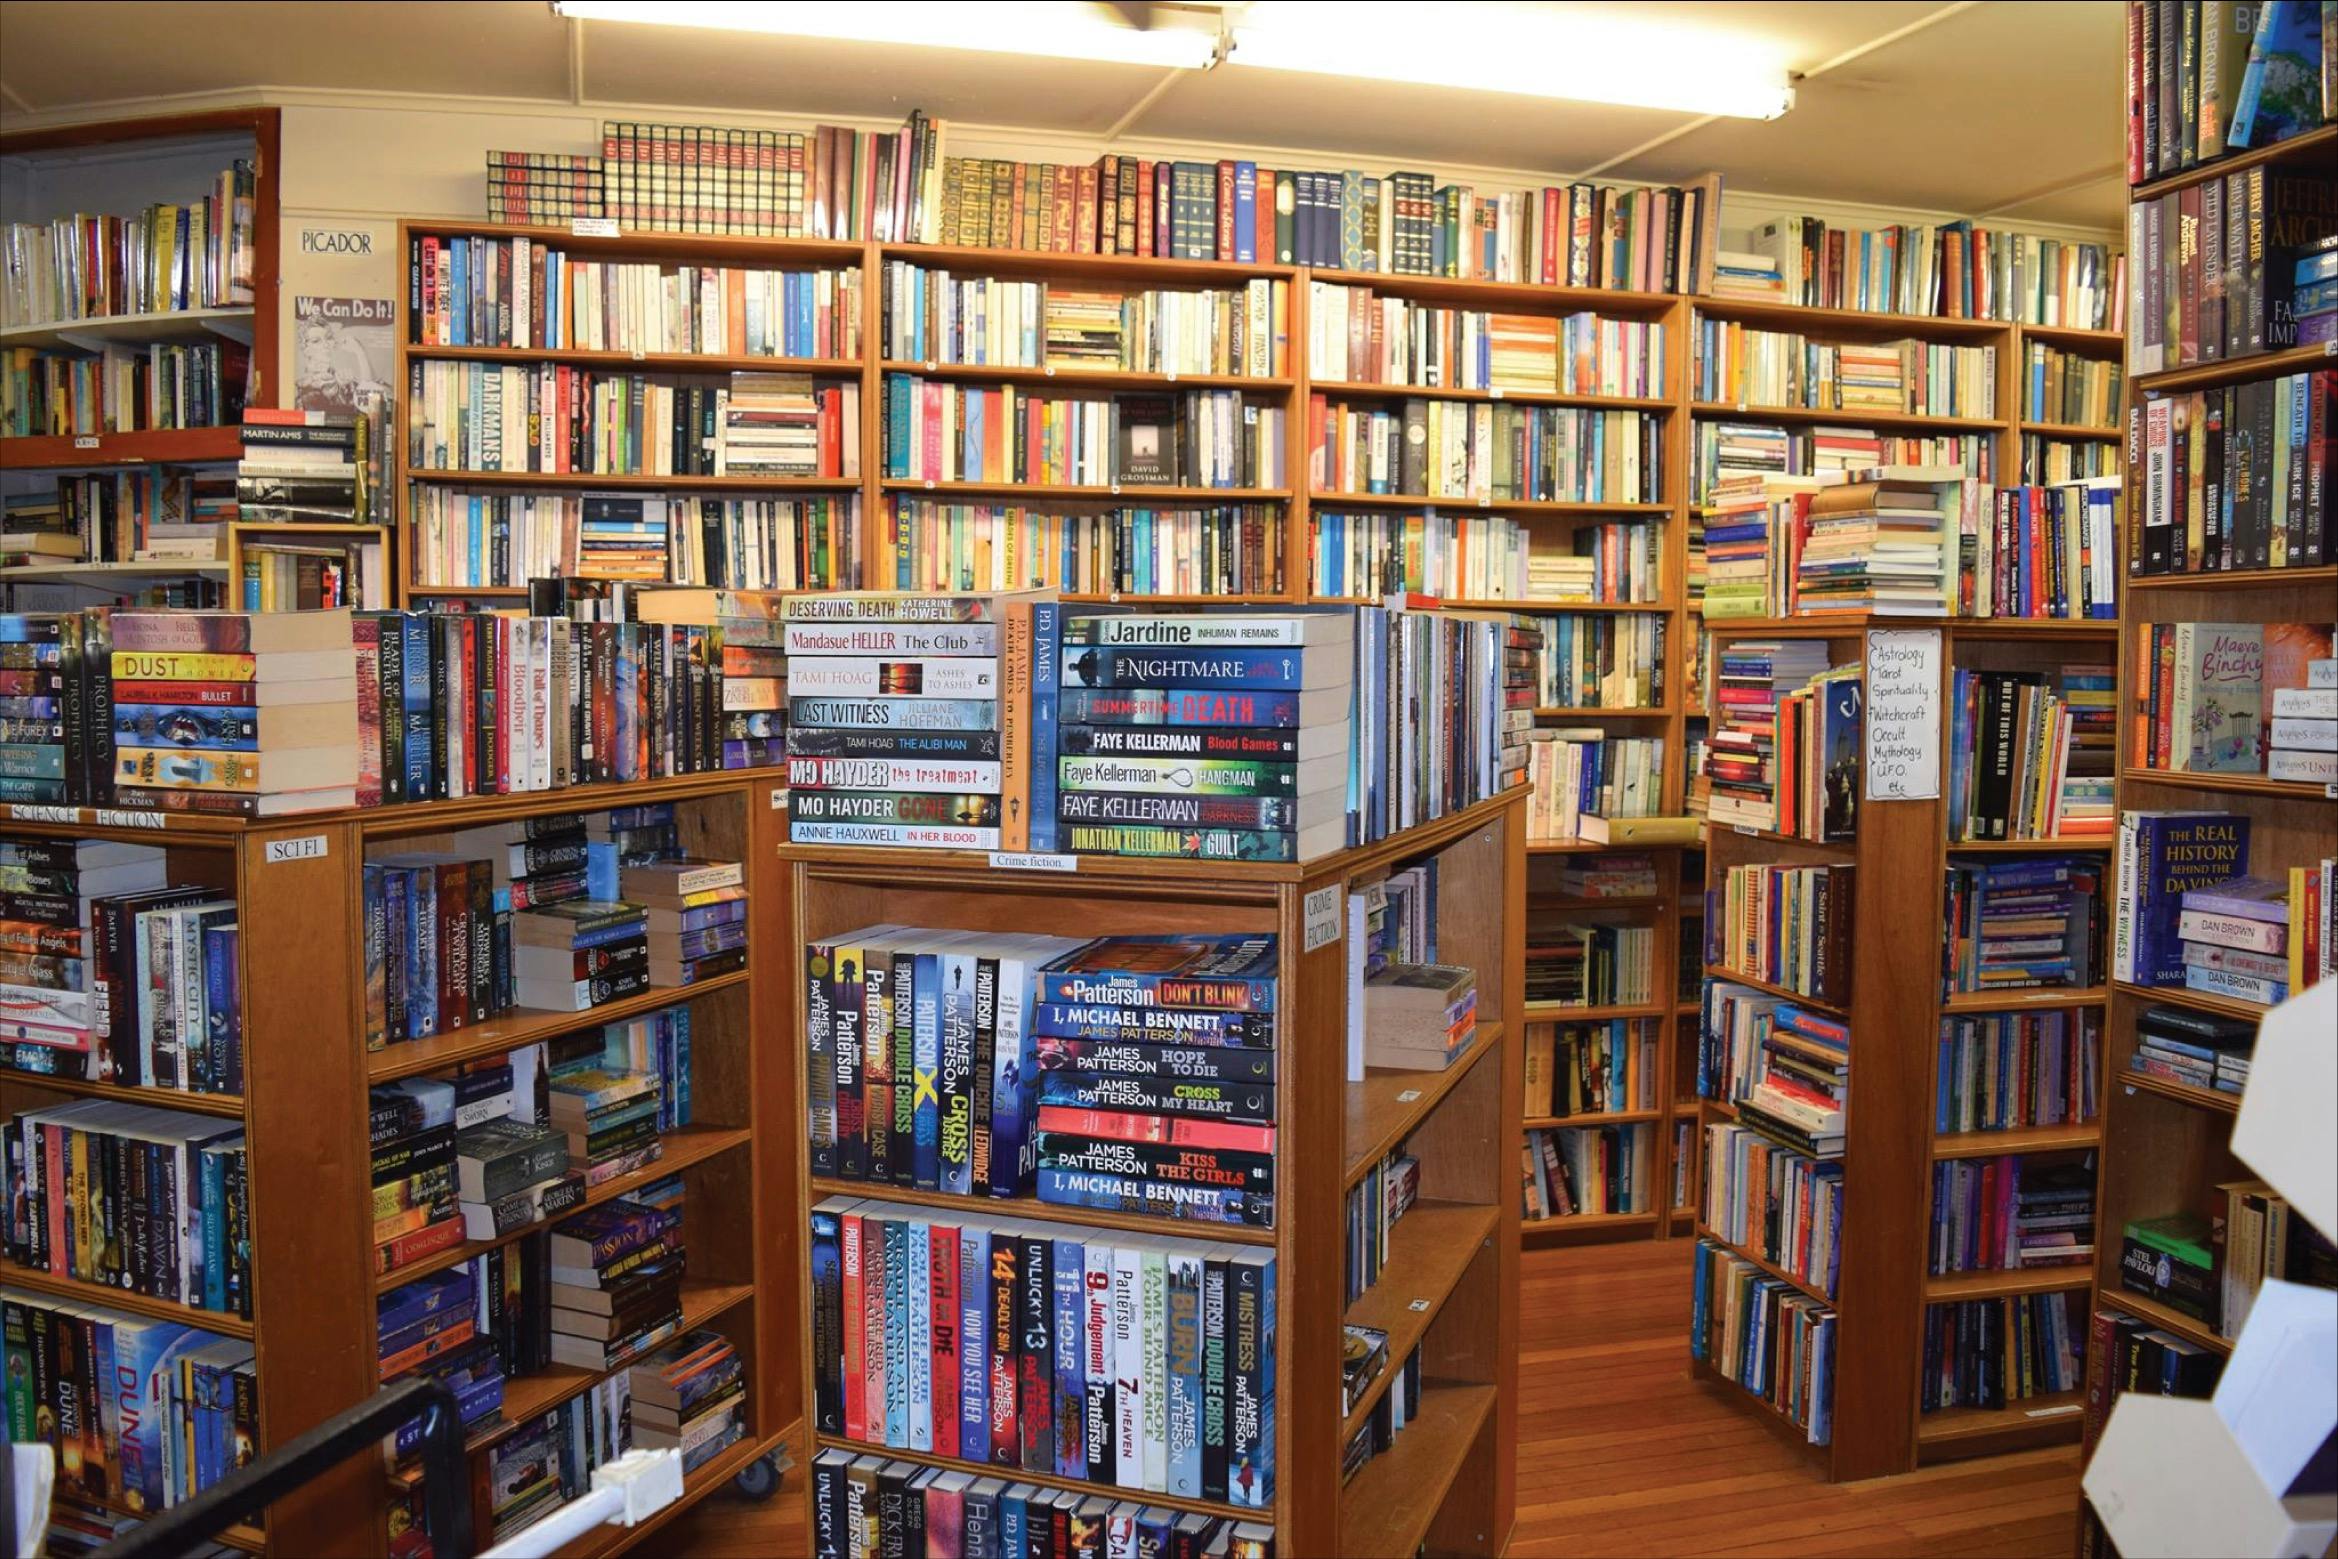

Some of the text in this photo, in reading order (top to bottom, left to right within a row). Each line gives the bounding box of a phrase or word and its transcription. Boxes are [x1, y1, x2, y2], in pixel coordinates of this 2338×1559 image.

[2204, 30, 2218, 95] BROWN
[2250, 172, 2262, 262] JEFFREY ARCHER
[302, 231, 372, 254] PICADOR
[2181, 215, 2190, 266] Andrews
[297, 296, 393, 319] We Can Do It!
[521, 285, 529, 325] ATWOOD
[483, 372, 501, 463] DARKMANS
[2157, 406, 2168, 448] WEAPONS
[243, 429, 279, 439] MARTIN
[280, 430, 302, 440] AMIS
[2149, 419, 2158, 448] CHOICE
[1120, 474, 1170, 482] GROSSMAN
[1130, 465, 1160, 473] DAVID
[2310, 460, 2320, 507] PROPHET
[789, 601, 896, 618] DESERVING DEATH
[900, 600, 954, 608] KATHERINE
[900, 607, 954, 621] HOWELL
[792, 632, 969, 650] Mandasue HELLER The Club
[1111, 621, 1280, 643] Jardine INHUMAN REMAINS
[2213, 634, 2261, 653] Maeve
[124, 657, 180, 677] DUST
[383, 631, 392, 698] FORTRIU
[391, 632, 400, 697] BLADE OF
[409, 628, 421, 686] MIRROR
[1878, 644, 1925, 669] Astrology
[2201, 651, 2264, 683] Binchy
[792, 671, 873, 685] TAMI HOAG
[1116, 658, 1125, 679] THE
[1126, 657, 1244, 681] NIGHTMARE
[1876, 667, 1902, 679] Tarot
[201, 691, 232, 702] BULLET
[513, 663, 528, 736] Bloodheir
[1872, 684, 1929, 701] Spirituality
[69, 679, 81, 761] PROPHECY
[95, 675, 109, 761] PROPHECY
[437, 659, 446, 769] ORCS INFERNO
[796, 703, 890, 725] LAST WITNESS
[907, 703, 955, 714] JILLIANE
[1091, 700, 1178, 715] SUMMERTIME
[1182, 695, 1254, 723] DEATH
[1873, 705, 1926, 722] Witchcraft
[900, 714, 962, 728] HOFFMAN
[1997, 681, 2013, 776] OUT OF THIS WORLD
[845, 737, 967, 750] TAMI HOAG THE ALIBI MAN
[1093, 733, 1279, 752] FAYE KELLERMAN Blood Games
[1872, 727, 1906, 743] Occult
[409, 714, 421, 781] MARILLIER
[1873, 747, 1922, 763] Mythology
[789, 760, 977, 787] MO HAYDER the treatment
[1064, 762, 1256, 787] Faye Kellerman HANGMAN
[1888, 782, 1906, 793] etc
[12, 806, 162, 828] SCIENCE FICTION
[798, 796, 949, 822] MO HAYDER GONE
[1063, 795, 1099, 817] FAYE
[1102, 797, 1199, 821] KELLERMAN
[798, 826, 977, 843] ANNIE HAUXWELL IN HER BLOOD
[1071, 828, 1239, 856] JONATHAN KELLERMAN GUILT
[2168, 825, 2237, 842] THE REAL
[273, 839, 318, 860] SCI FI
[996, 854, 1065, 868] Crime fiction.
[2166, 844, 2240, 862] HISTORY
[2171, 863, 2231, 875] BEHIND THE
[2165, 878, 2187, 894] DA
[1307, 890, 1332, 916] CRIME
[1307, 919, 1337, 948] FICTION
[2117, 896, 2130, 961] THE WITNESS
[2201, 919, 2220, 934] DAN
[2221, 921, 2256, 938] BROWN
[458, 911, 468, 998] CROSSROADS
[186, 920, 199, 1025] MYSTIC CITY
[1107, 975, 1138, 989] James
[2208, 971, 2261, 991] DAN BROWN
[1073, 980, 1246, 1006] Patterson DON'T BLINK
[1053, 1007, 1220, 1031] I, MICHAEL BENNETT
[1077, 1047, 1206, 1074] JAMES PATTERSON HOPE
[1172, 1063, 1218, 1077] TO DIE
[1161, 1096, 1234, 1113] MY HEART
[1173, 1085, 1221, 1100] CROSS
[951, 1095, 969, 1165] CROSS
[1085, 1142, 1135, 1160] JAMES
[1179, 1152, 1217, 1169] KISS
[1059, 1153, 1147, 1175] PATTERSON
[1155, 1163, 1245, 1185] THE GIRLS
[543, 1191, 576, 1210] MARTIN
[153, 1219, 168, 1279] DAWN
[2132, 1248, 2150, 1265] STEL
[2125, 1255, 2156, 1277] PAVLOU
[1025, 1244, 1048, 1350] UNLUCKY 13
[1058, 1309, 1075, 1370] HOUR
[1086, 1297, 1108, 1375] Judgement
[1170, 1294, 1197, 1376] BURN
[1238, 1291, 1255, 1372] MISTRESS
[58, 1380, 74, 1435] DUNE
[117, 1365, 143, 1468] DUNE
[1235, 1374, 1247, 1454] PATTERSON
[1245, 1394, 1258, 1439] JAMES
[1088, 1384, 1105, 1464] Patterson
[1122, 1408, 1133, 1459] HEAVEN
